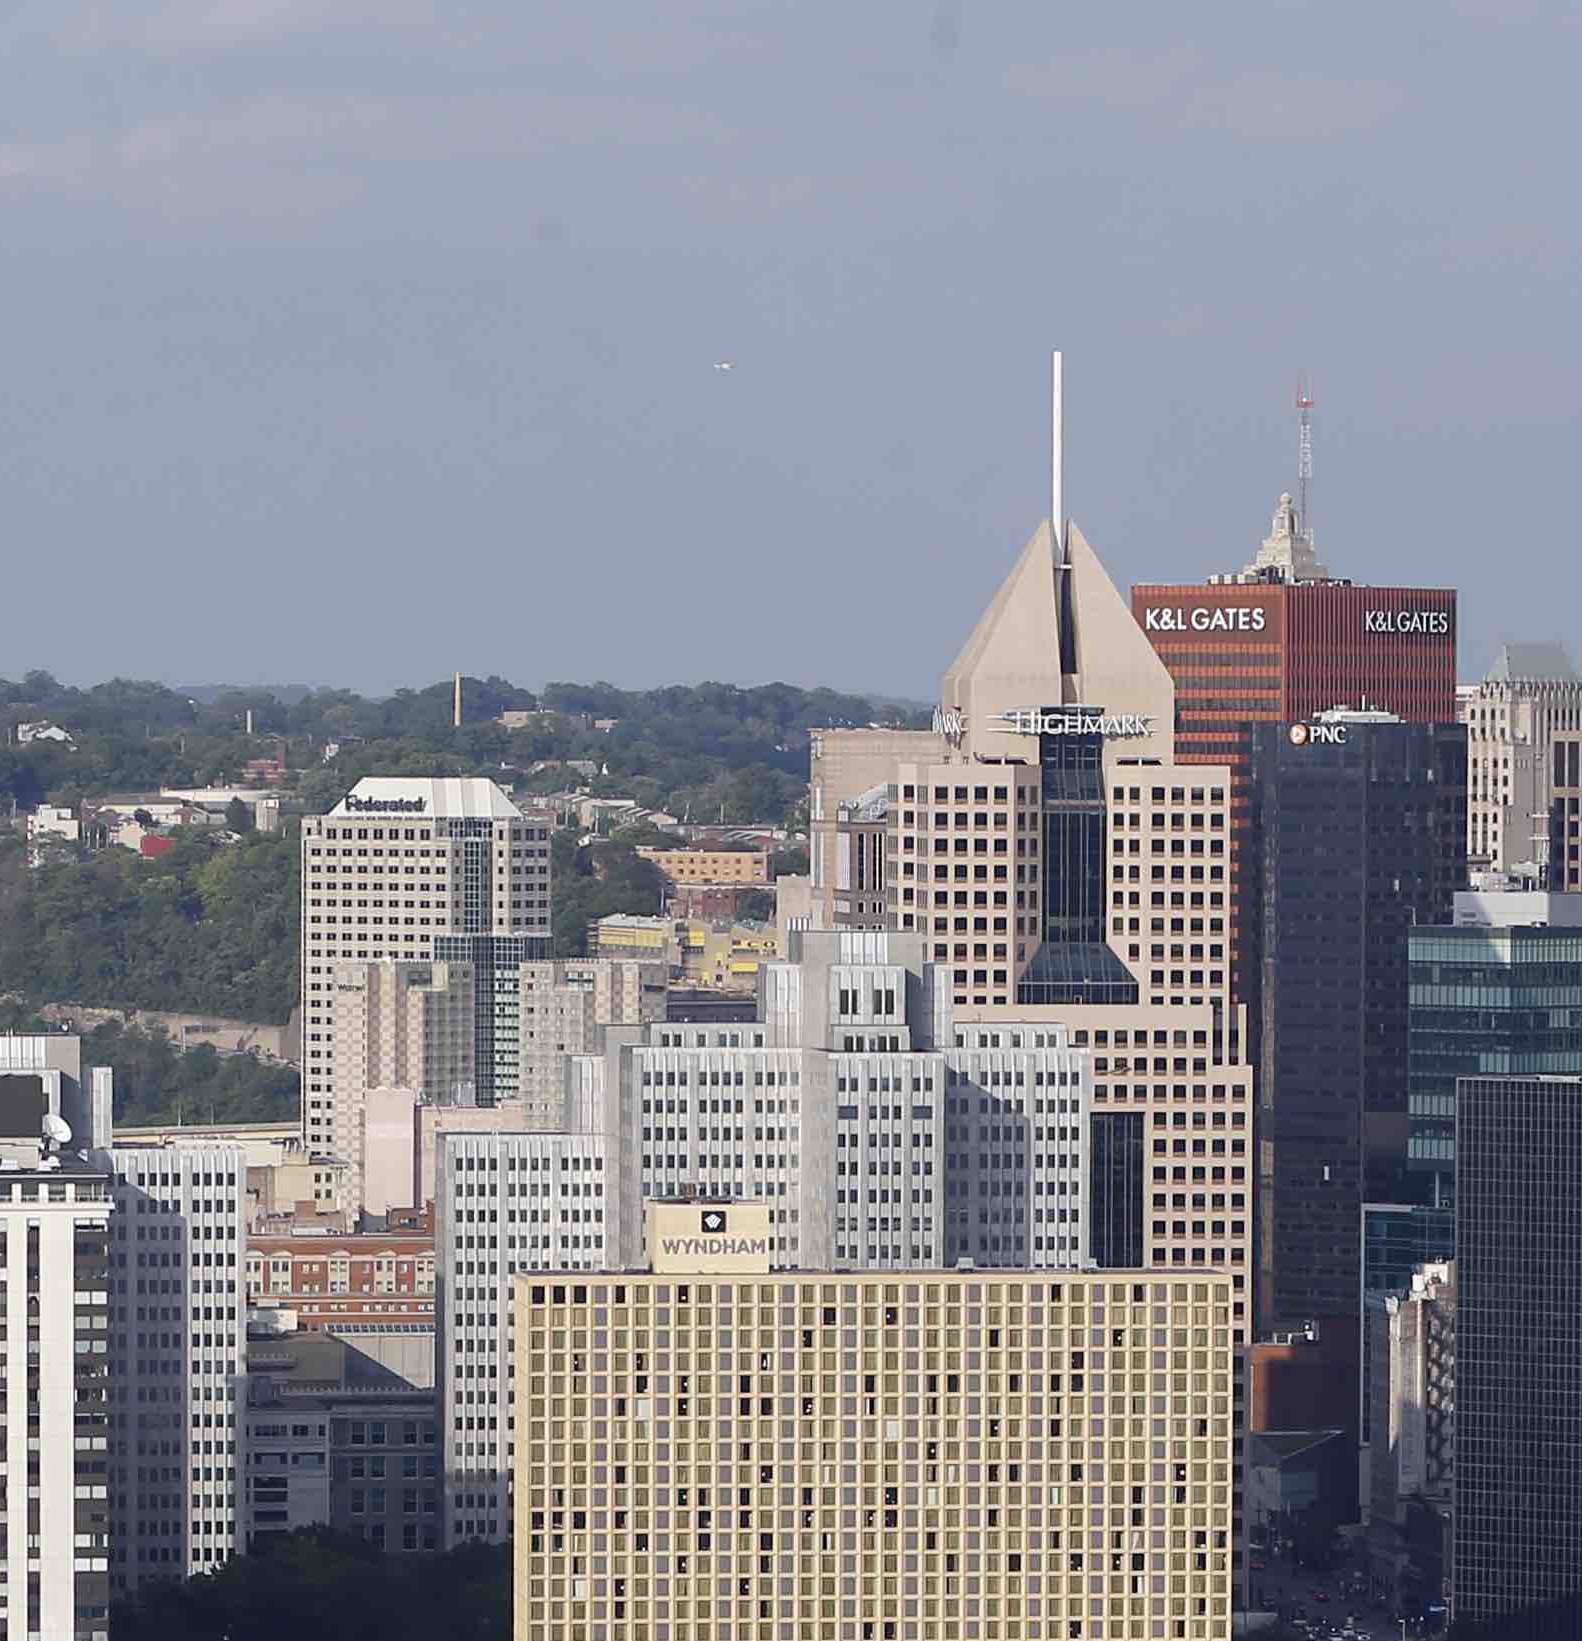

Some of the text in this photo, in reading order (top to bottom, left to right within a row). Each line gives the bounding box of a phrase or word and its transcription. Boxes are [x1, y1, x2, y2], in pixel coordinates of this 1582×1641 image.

[1145, 607, 1266, 631] K&L GATES
[1365, 611, 1448, 634] K&L GATES
[1016, 711, 1151, 736] HIGHMARK
[1310, 726, 1347, 744] PNC
[345, 794, 427, 812] Federated
[662, 1238, 766, 1255] WYNDHAM
